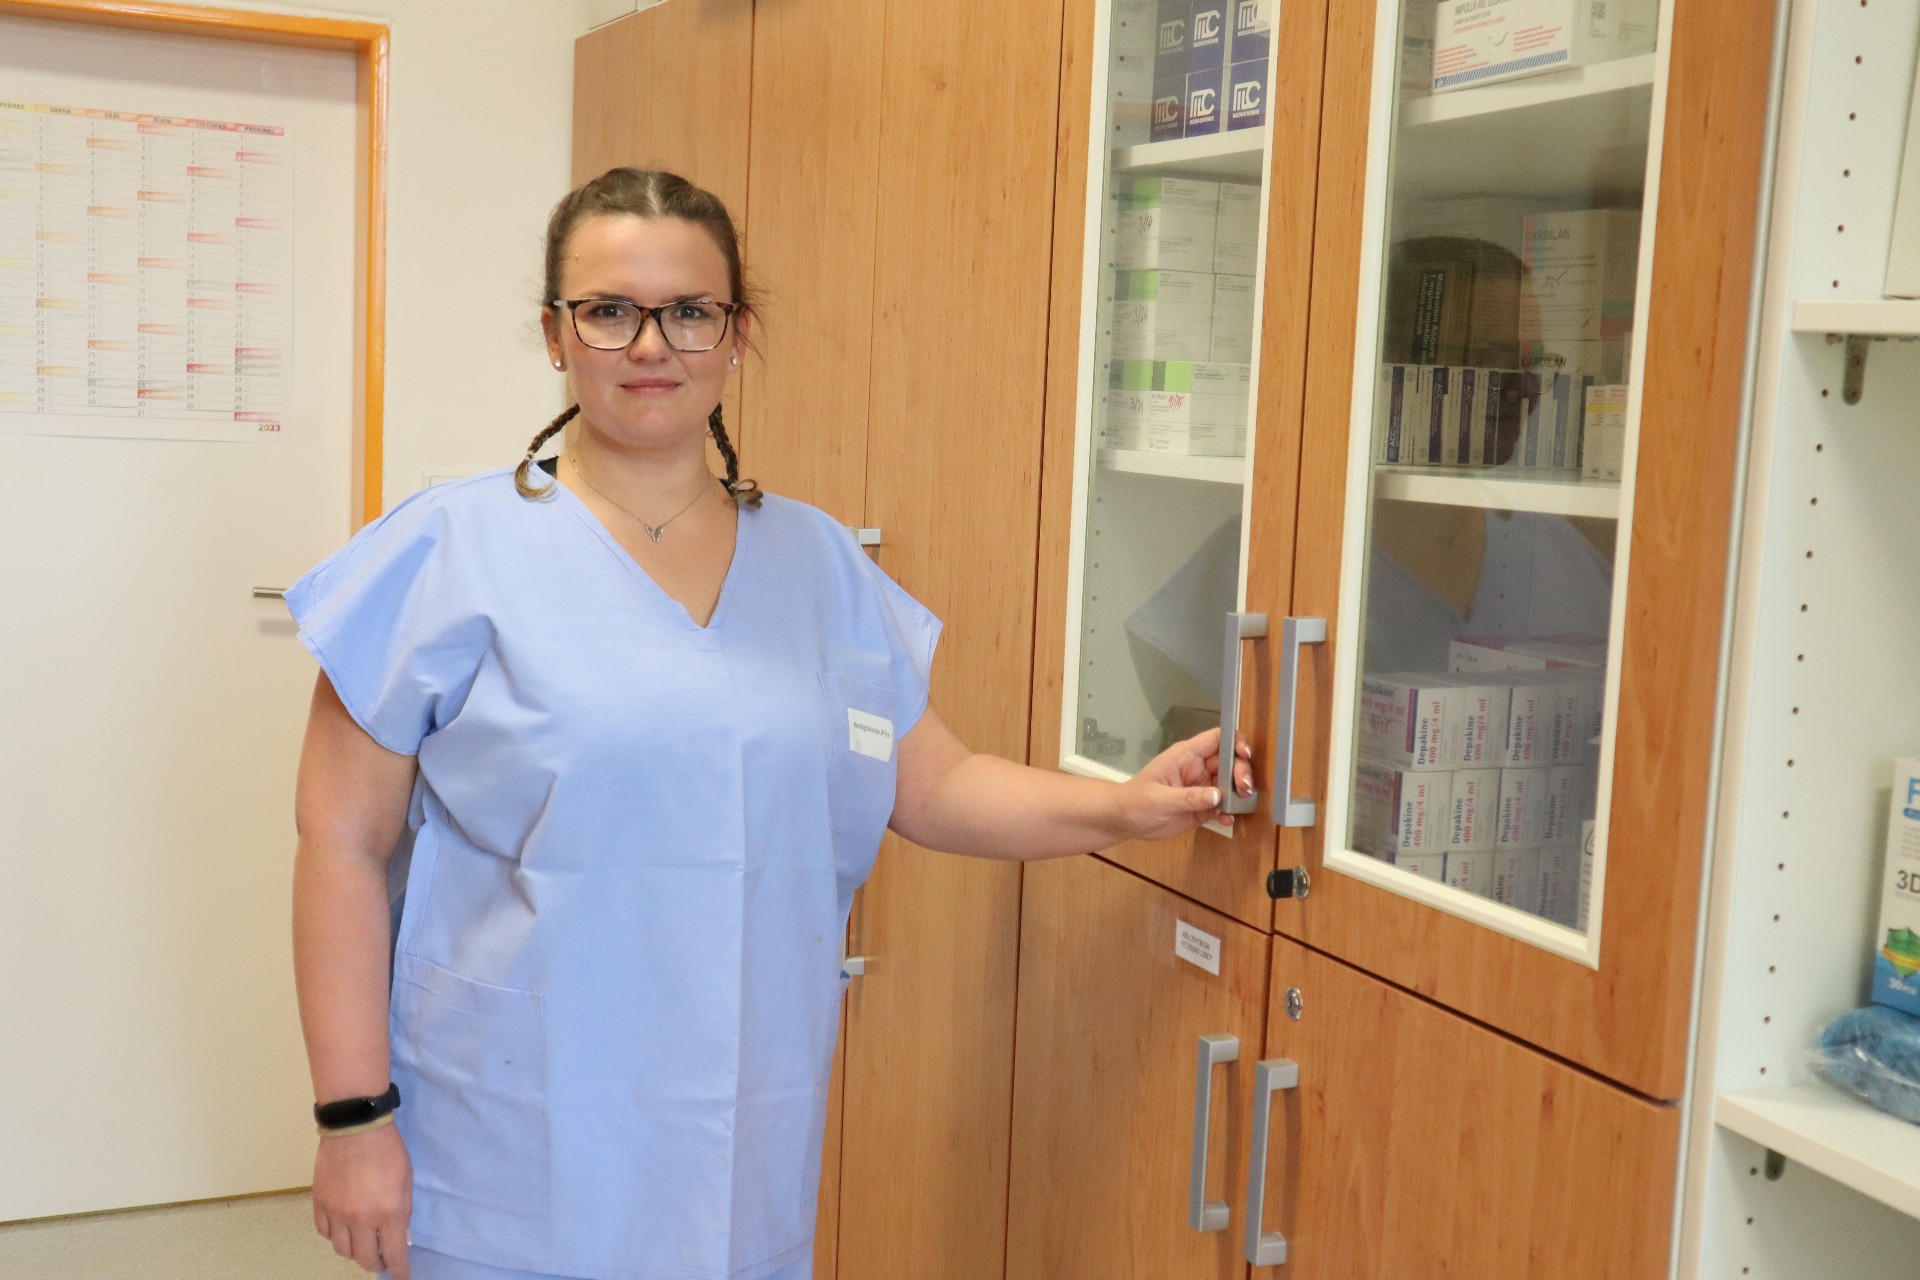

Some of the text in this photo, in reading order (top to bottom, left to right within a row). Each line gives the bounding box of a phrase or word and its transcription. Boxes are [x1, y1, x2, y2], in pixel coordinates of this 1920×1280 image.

[196, 122, 227, 130] LISTOPAD
[244, 126, 275, 135] PROSINEC
[258, 424, 280, 432] 2023
[1418, 718, 1429, 764] Depakine
[1429, 701, 1440, 764] 400 mg/4 ml
[1464, 715, 1474, 761] Depakine
[1474, 699, 1486, 760] 400 mg/4 ml
[1512, 715, 1522, 760] Depakine
[1523, 744, 1531, 760] 400
[1527, 700, 1535, 712] ml
[1402, 801, 1413, 848] Depakine
[1414, 785, 1425, 848] 400 mg/4 ml
[1452, 798, 1463, 844] Depakine
[1463, 782, 1475, 844] 400 mg/4 ml
[1502, 797, 1512, 842] Depakine
[1512, 781, 1524, 842] 400 mg/4 ml
[1546, 794, 1557, 839] Depakine
[1461, 862, 1469, 875] ml
[1539, 872, 1549, 916] Depakine
